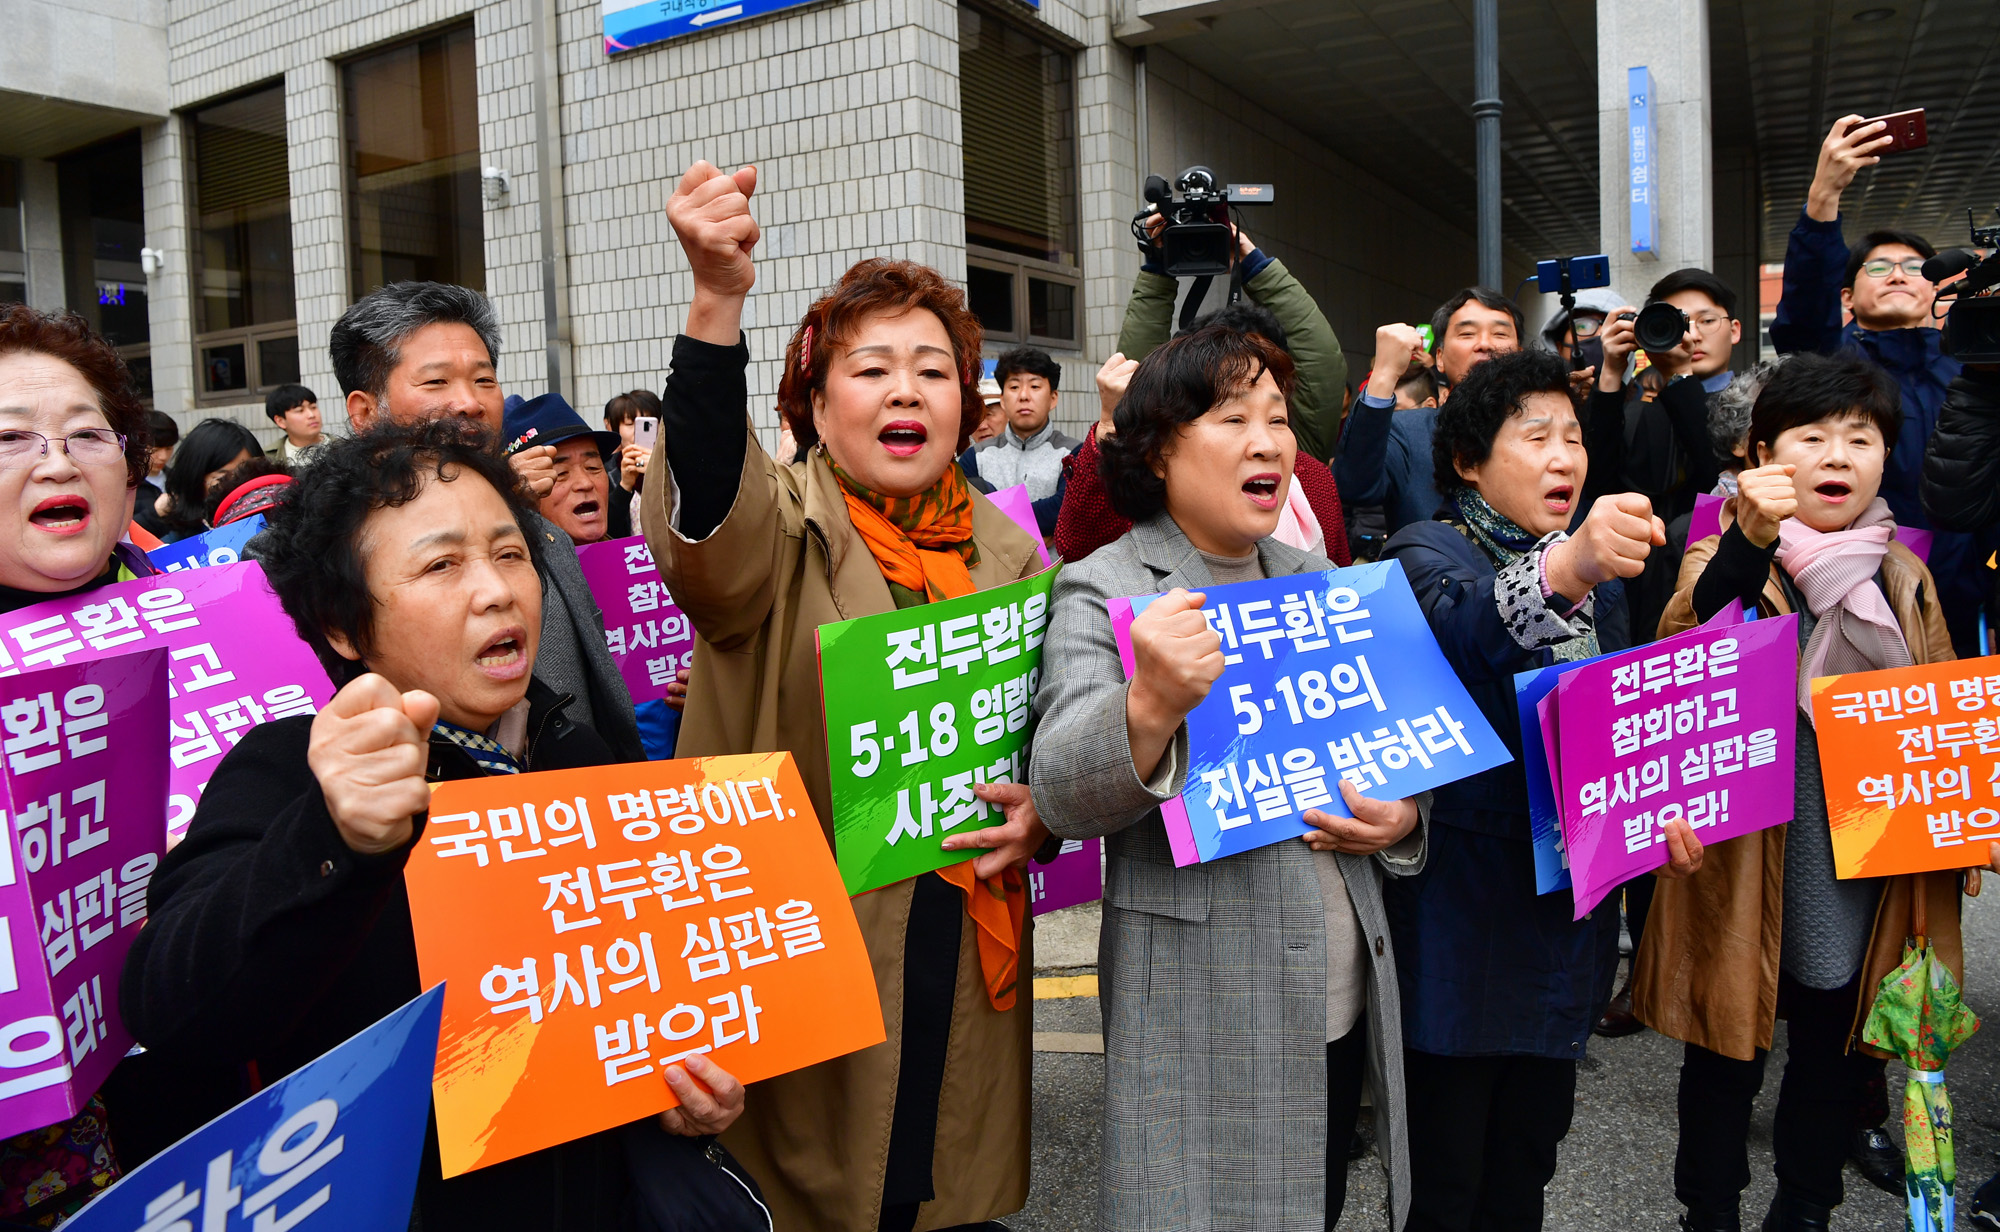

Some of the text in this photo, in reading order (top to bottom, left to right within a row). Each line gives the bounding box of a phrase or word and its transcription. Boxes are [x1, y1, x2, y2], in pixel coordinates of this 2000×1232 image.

[886, 592, 1047, 690] 전두환은
[1203, 587, 1373, 666] 전두환은
[1610, 637, 1740, 705] 전두환은
[1229, 655, 1387, 736] 5·18의
[1610, 688, 1740, 757] 참회하고
[1831, 682, 1939, 724] 국민의
[885, 746, 1030, 846] 사죄하
[1201, 706, 1476, 831] 진실을 밝혀라
[1579, 728, 1778, 817] 역사의 심판을
[1857, 765, 1971, 810] 역사의
[0, 779, 109, 887] 하고
[429, 777, 797, 867] 국민의 명령이다.
[1623, 790, 1729, 854] 받으라!
[538, 843, 753, 934] 전두환은
[479, 899, 826, 1024] 역사의 심판을
[594, 985, 762, 1087] 받으라
